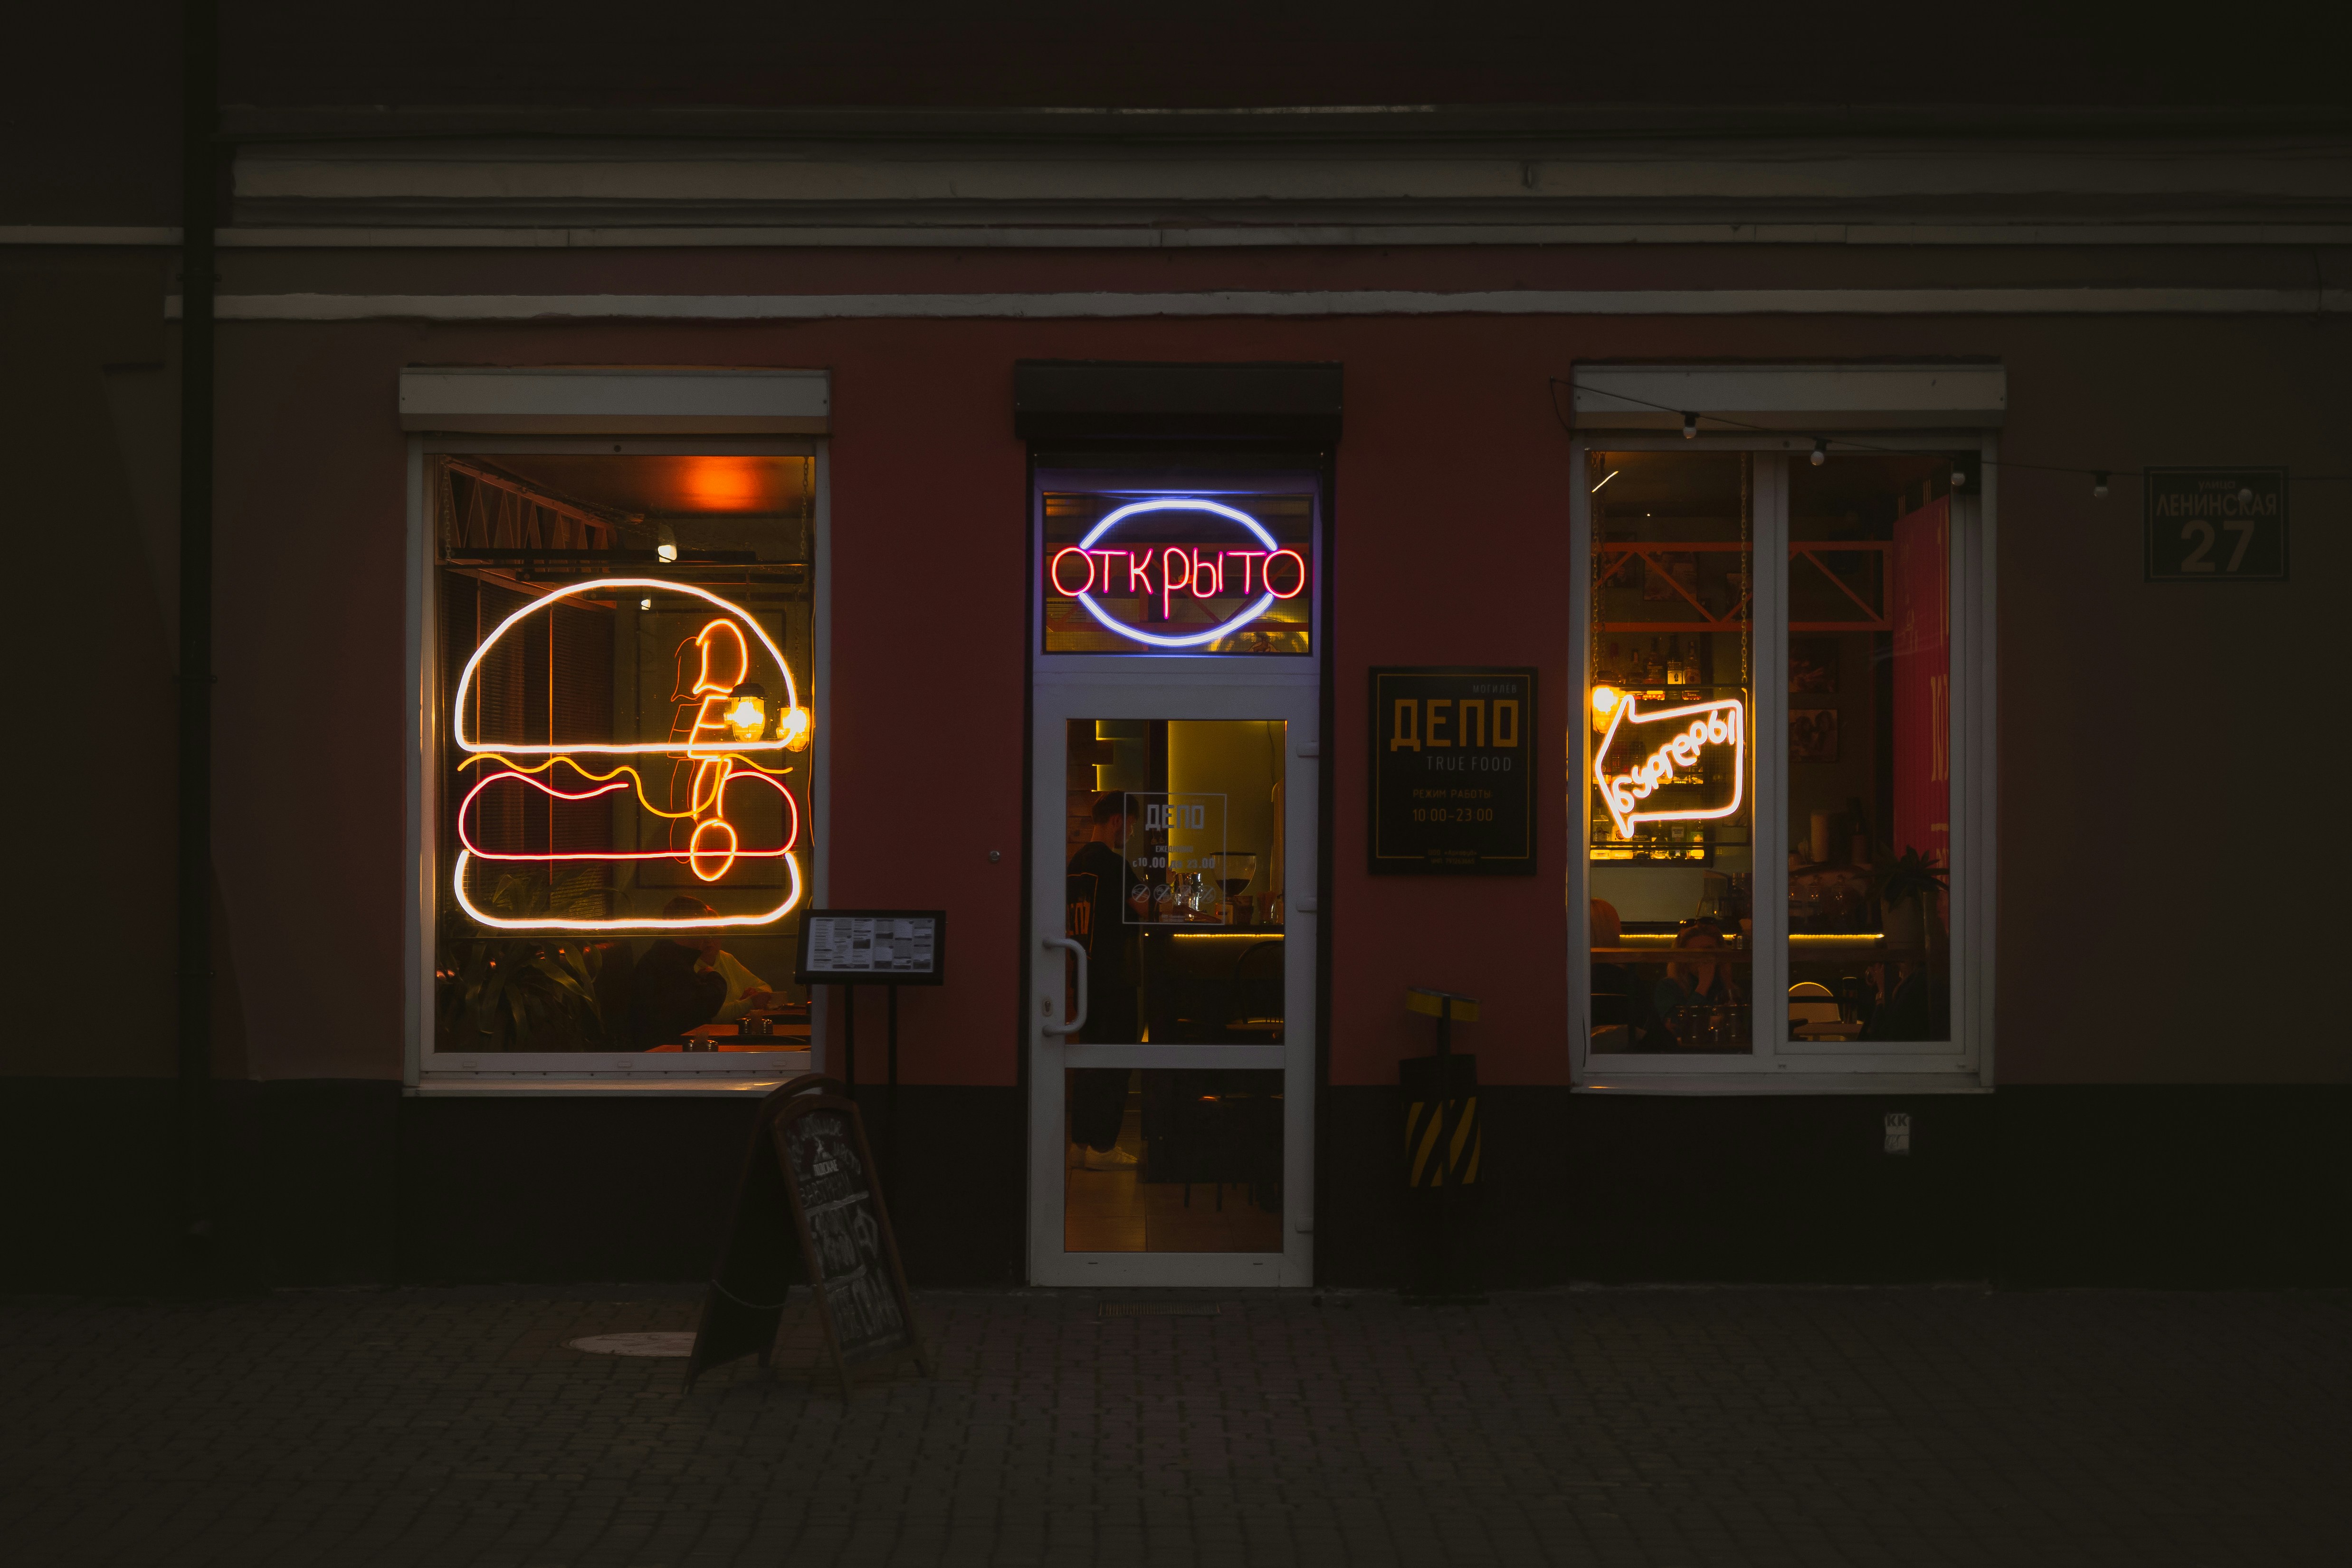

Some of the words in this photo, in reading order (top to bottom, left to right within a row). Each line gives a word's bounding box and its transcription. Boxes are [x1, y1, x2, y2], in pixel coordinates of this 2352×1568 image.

[2198, 480, 2236, 492] улица
[2156, 494, 2276, 517] ЛЕНИНСКАЯ
[2181, 520, 2255, 572] 27
[1051, 546, 1305, 619] ОТКРЫТО
[1390, 699, 1519, 752] ДЕПО
[1427, 756, 1465, 770] TRUE
[1472, 757, 1512, 771] FOOD
[1413, 789, 1446, 798] РЕЖИМ
[1145, 804, 1205, 831] ДЕПО
